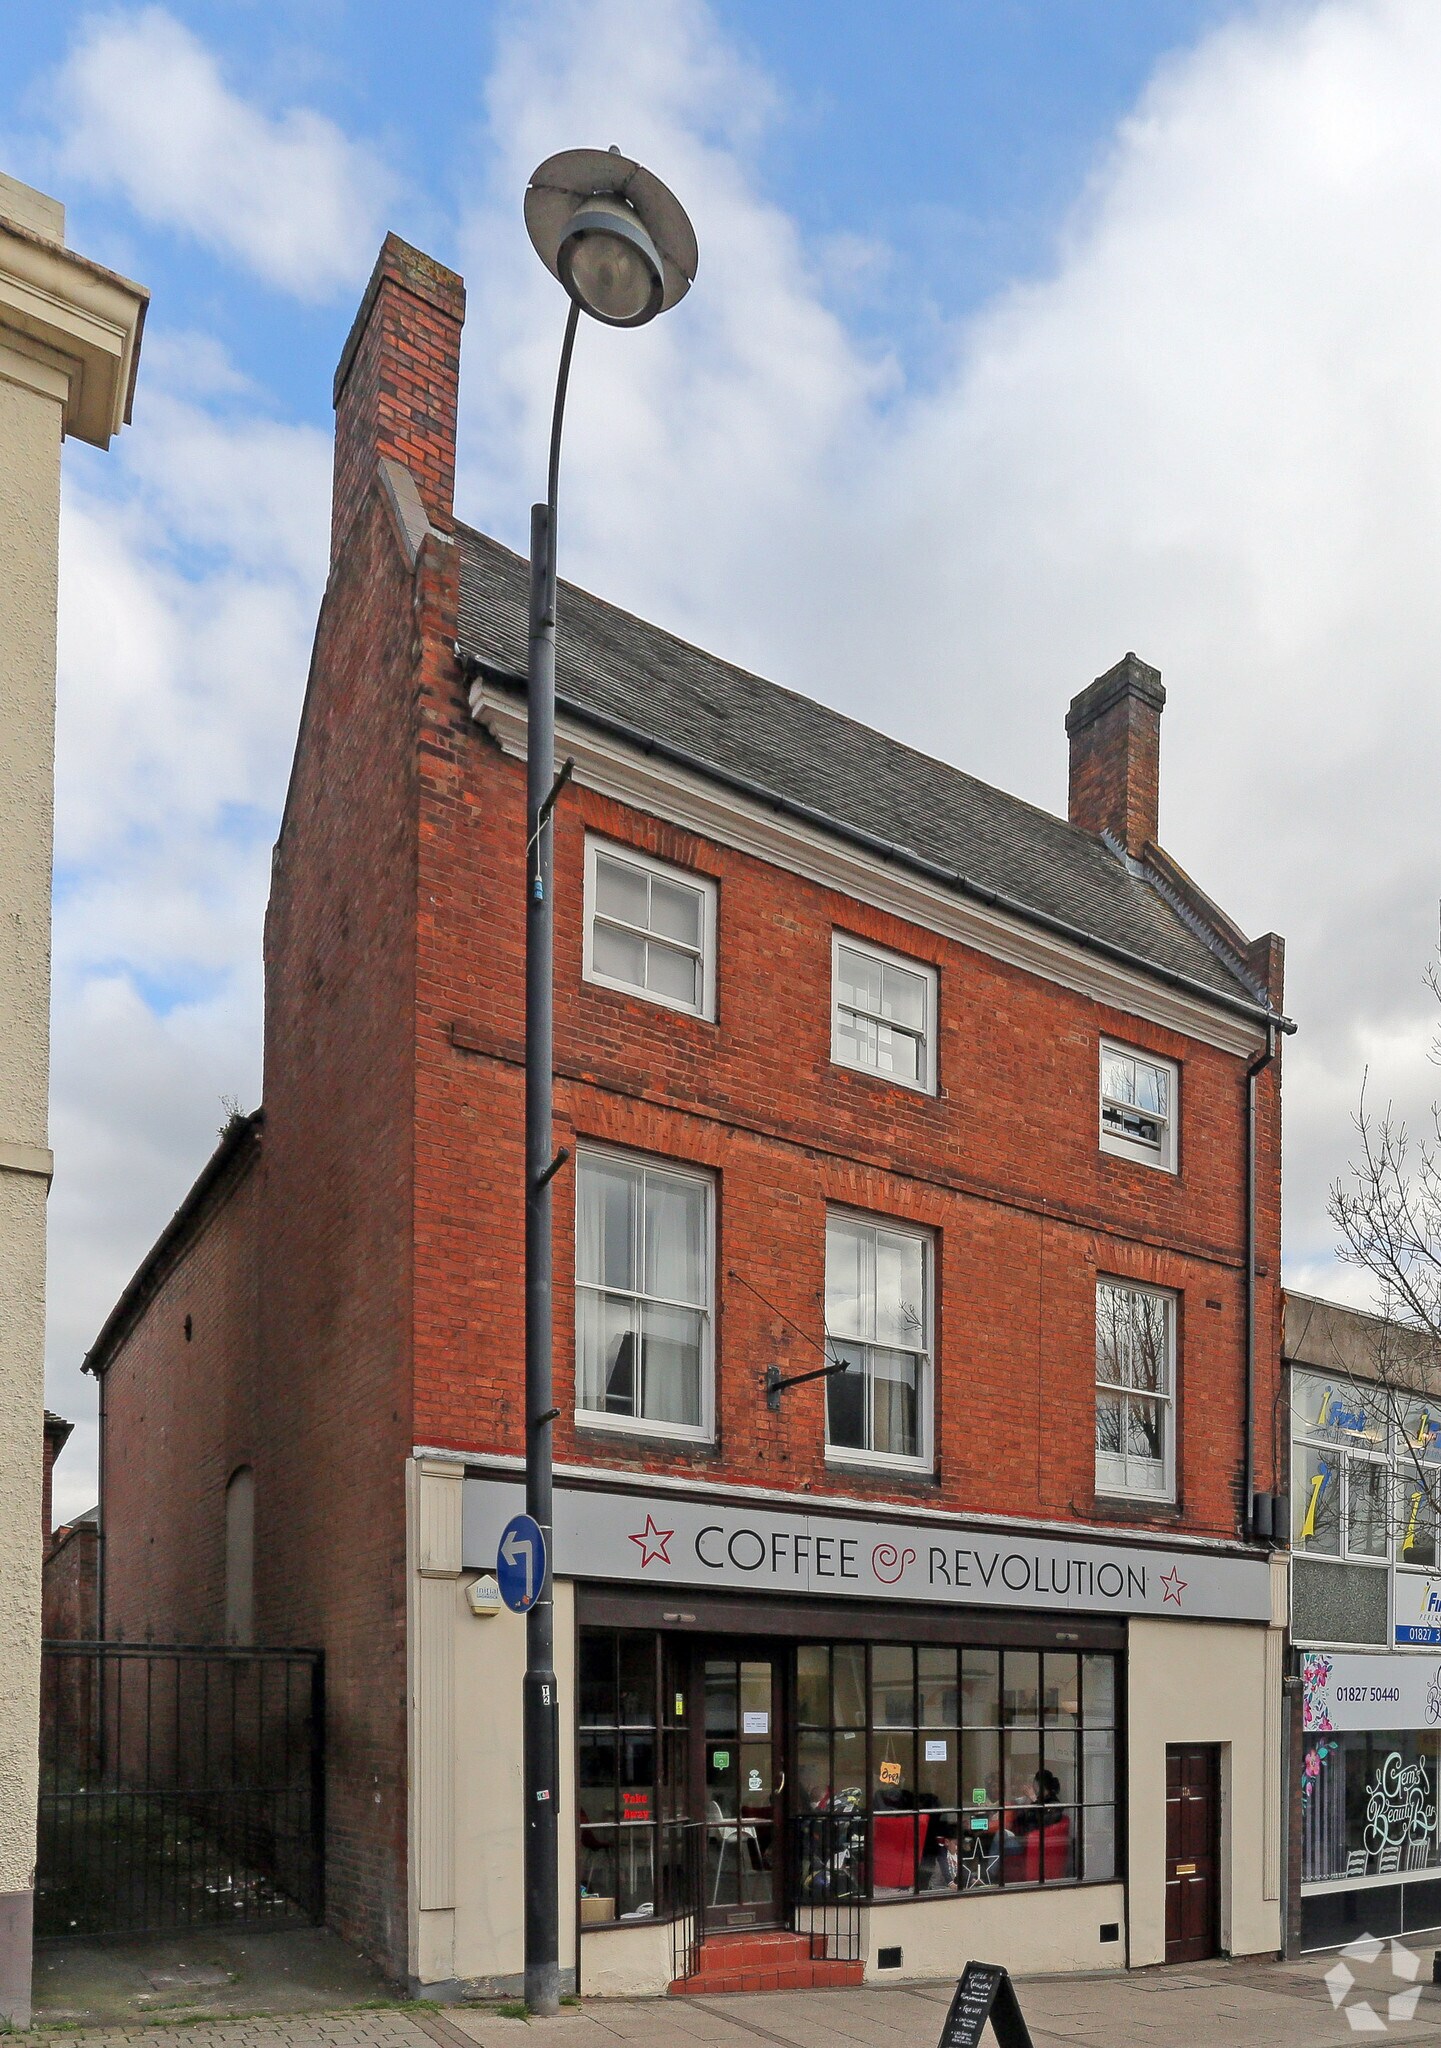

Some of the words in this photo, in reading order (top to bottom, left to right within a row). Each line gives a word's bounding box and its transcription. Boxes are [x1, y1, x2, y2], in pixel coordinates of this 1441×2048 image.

[695, 1526, 859, 1579] COFFEE
[928, 1546, 1147, 1599] REVOLUTION
[476, 1586, 499, 1595] Initial
[1409, 1628, 1431, 1641] 01827
[1336, 1686, 1367, 1702] 01827
[1370, 1687, 1400, 1702] 50440
[881, 1767, 899, 1781] Open
[622, 1793, 648, 1804] Take
[623, 1809, 649, 1820] Away
